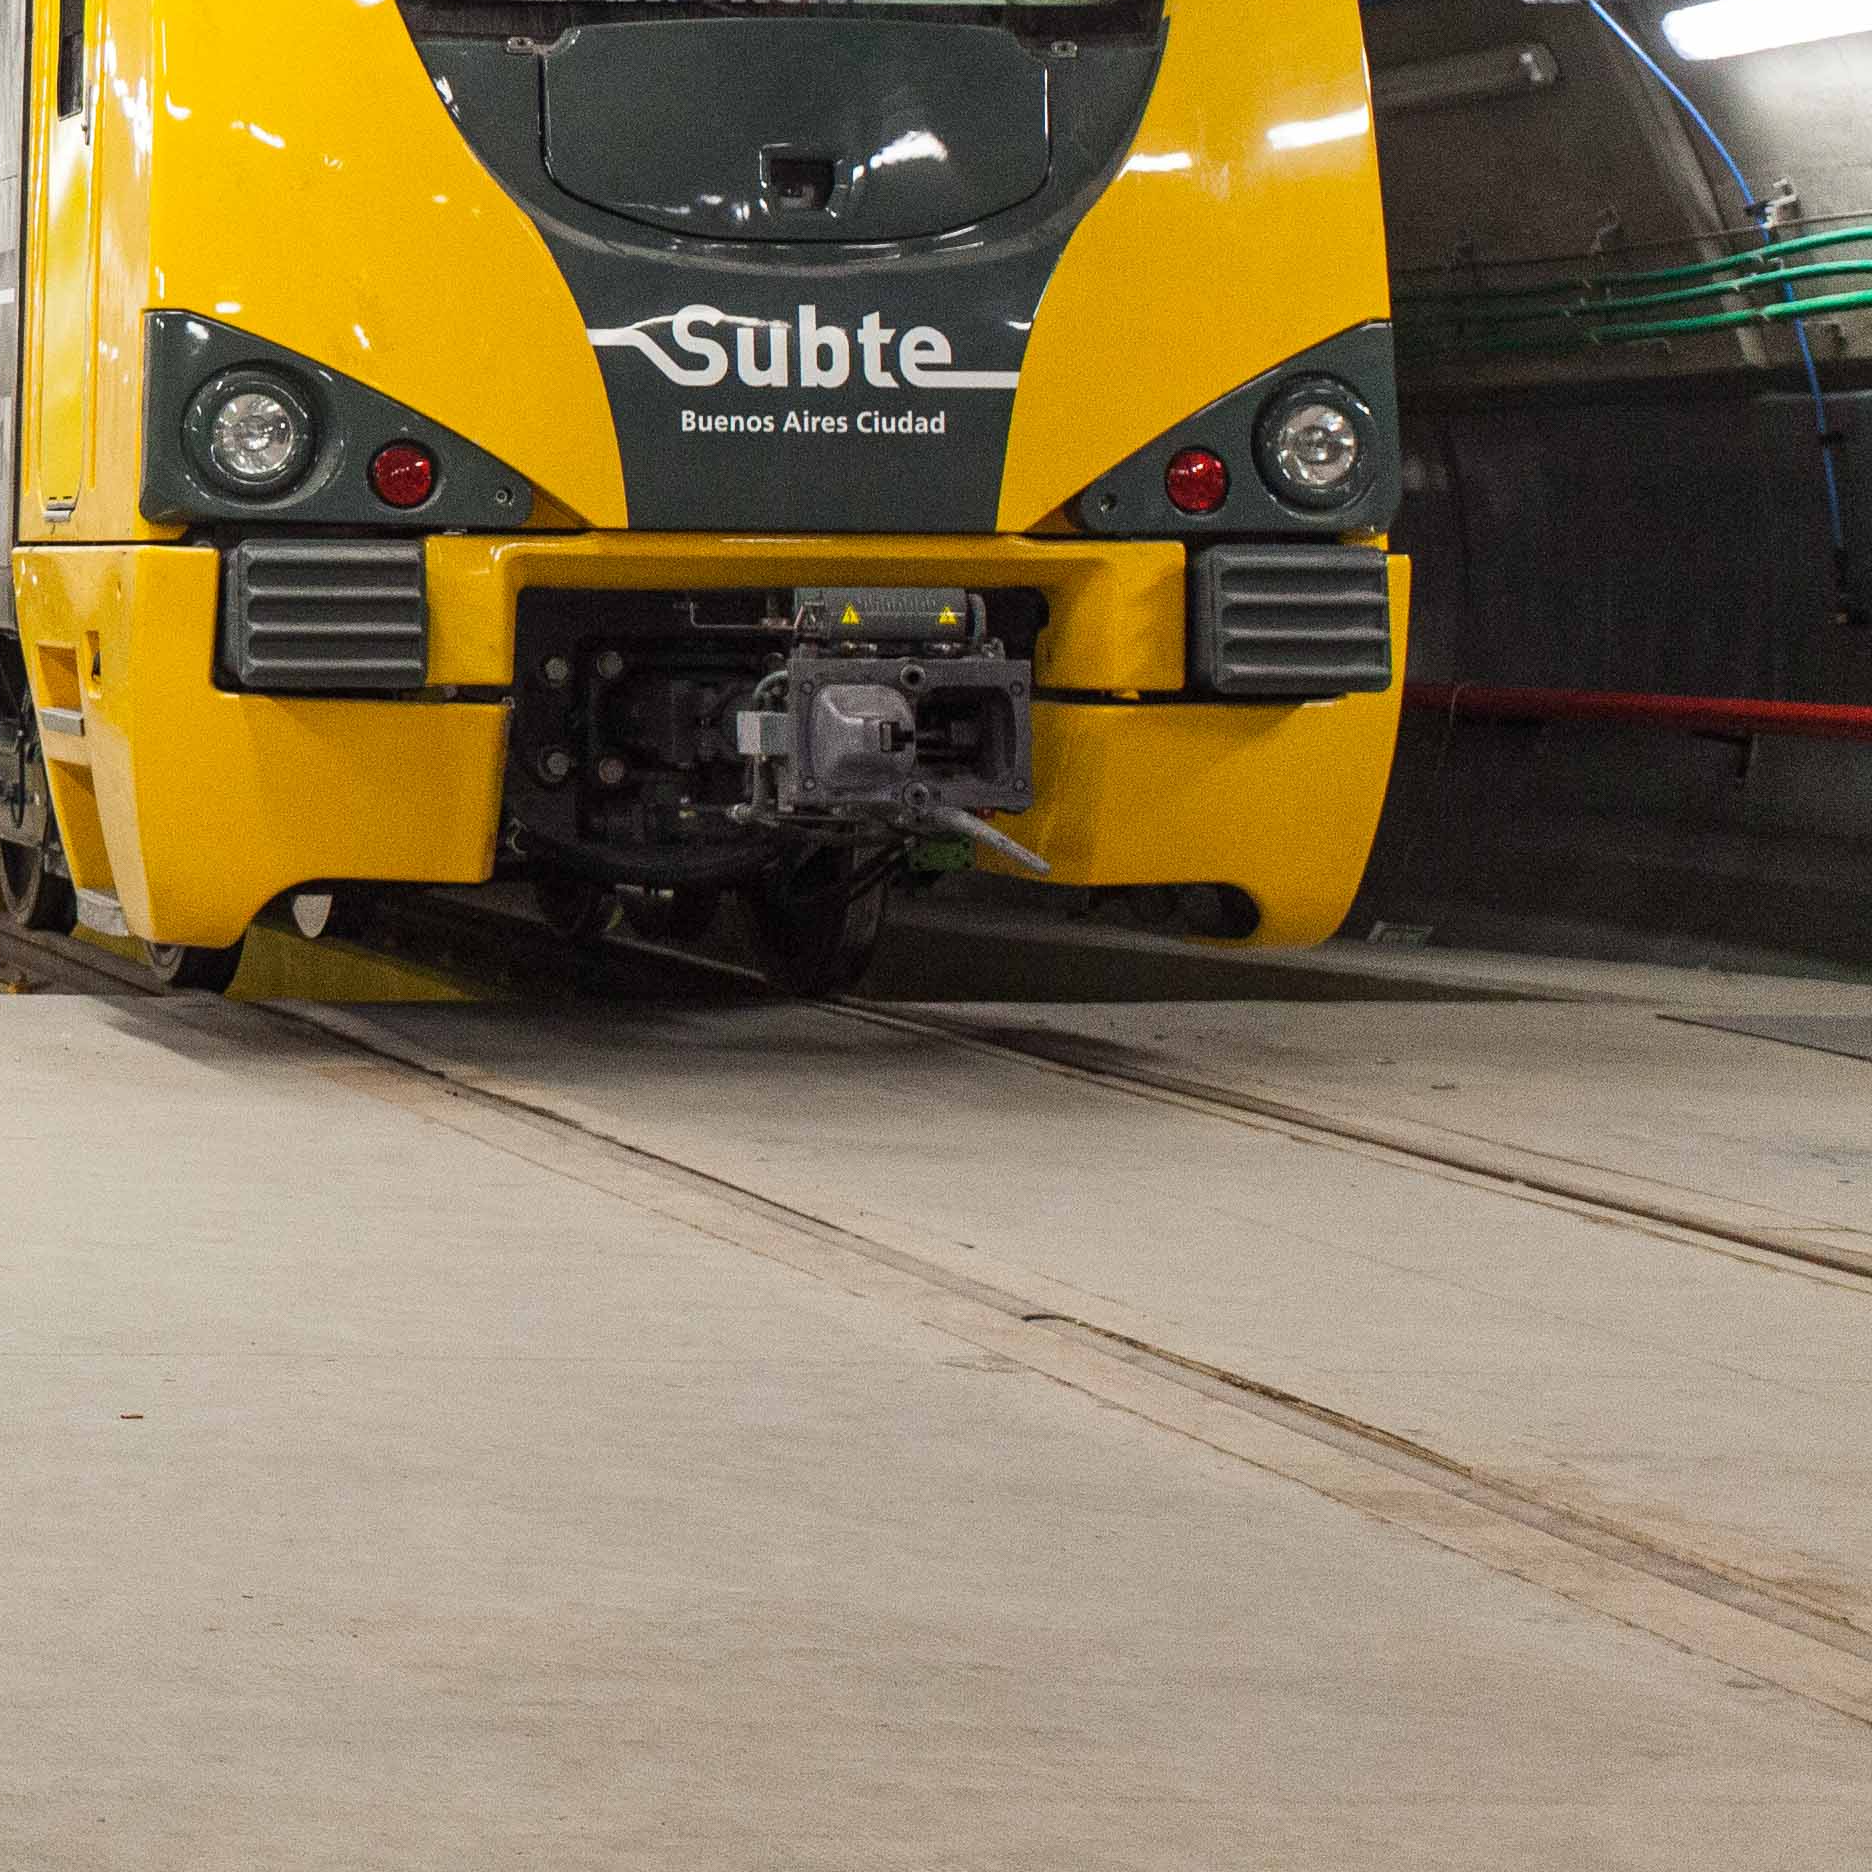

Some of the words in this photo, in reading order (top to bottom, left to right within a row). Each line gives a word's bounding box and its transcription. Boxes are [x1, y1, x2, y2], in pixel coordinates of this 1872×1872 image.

[670, 302, 954, 390] Subte
[680, 408, 776, 434] Buenos
[782, 409, 849, 434] Aires
[856, 409, 947, 435] Ciudad
